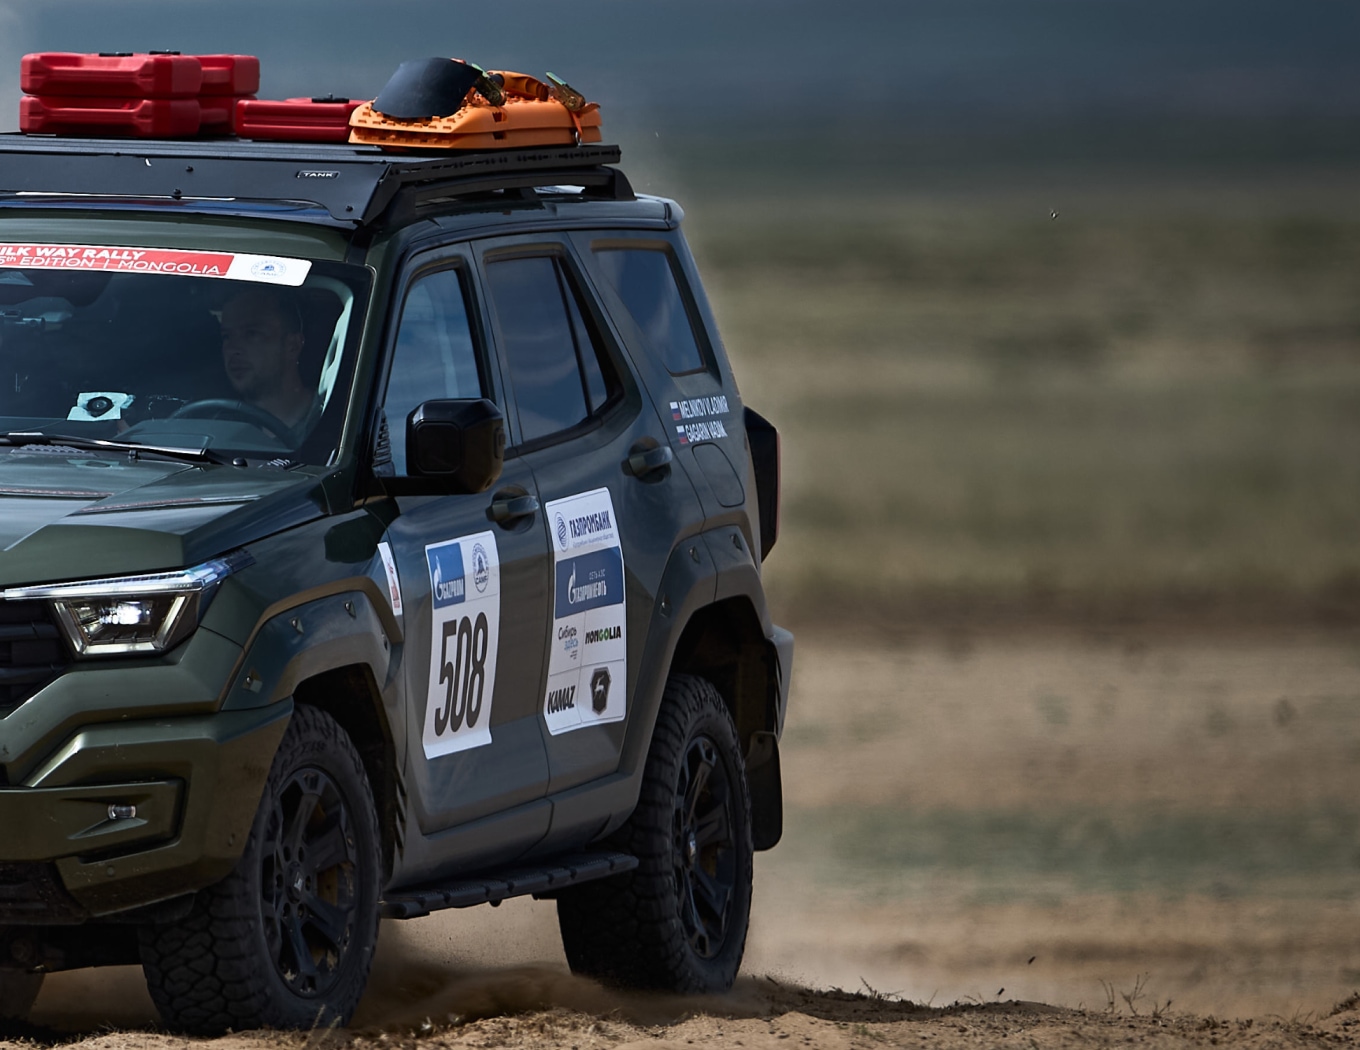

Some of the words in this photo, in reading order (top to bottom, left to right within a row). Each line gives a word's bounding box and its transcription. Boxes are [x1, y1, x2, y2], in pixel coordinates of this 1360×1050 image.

[19, 256, 96, 268] EDITION
[117, 259, 221, 275] MONGOLIA
[36, 247, 80, 258] WAY
[82, 249, 146, 260] RALLY
[569, 510, 612, 539] ГАЗПРОМБАНК
[585, 625, 622, 645] MONGOLIA
[434, 611, 489, 737] 508
[547, 685, 576, 715] KAMAZ
